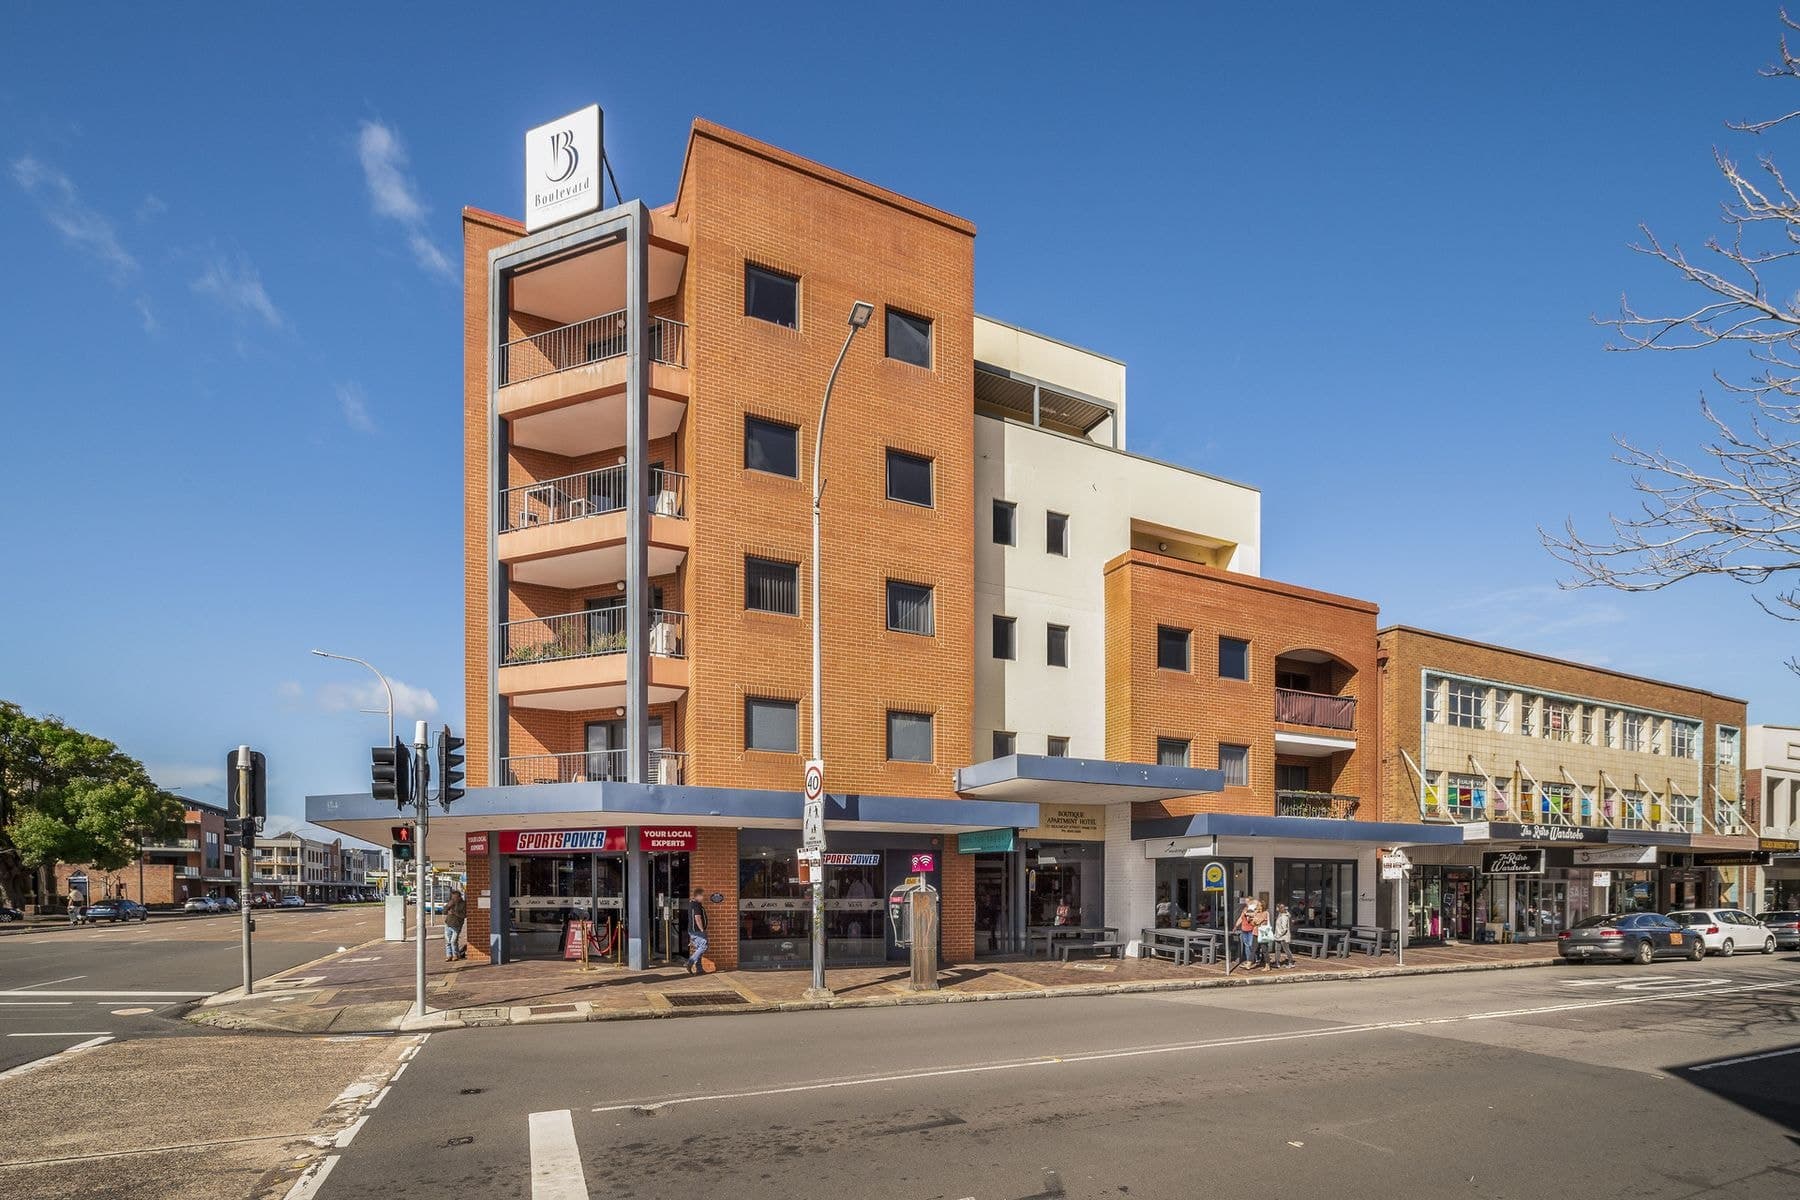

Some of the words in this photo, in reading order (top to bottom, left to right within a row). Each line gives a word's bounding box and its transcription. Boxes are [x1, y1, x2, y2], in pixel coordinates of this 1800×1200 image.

[534, 177, 590, 208] Boulevard
[807, 775, 819, 791] 40
[1057, 810, 1084, 818] BOUTIQUE
[1046, 817, 1079, 825] APARTMENT
[644, 830, 667, 838] YOUR
[667, 830, 693, 838] LOCAL
[1520, 825, 1532, 837] The
[1532, 825, 1550, 839] Retro
[1550, 826, 1584, 840] Wardrobe
[518, 831, 605, 849] SPORTSPOWER
[651, 839, 686, 847] EXPERTS
[1507, 852, 1528, 864] Retro
[1490, 860, 1532, 872] Wardrobe
